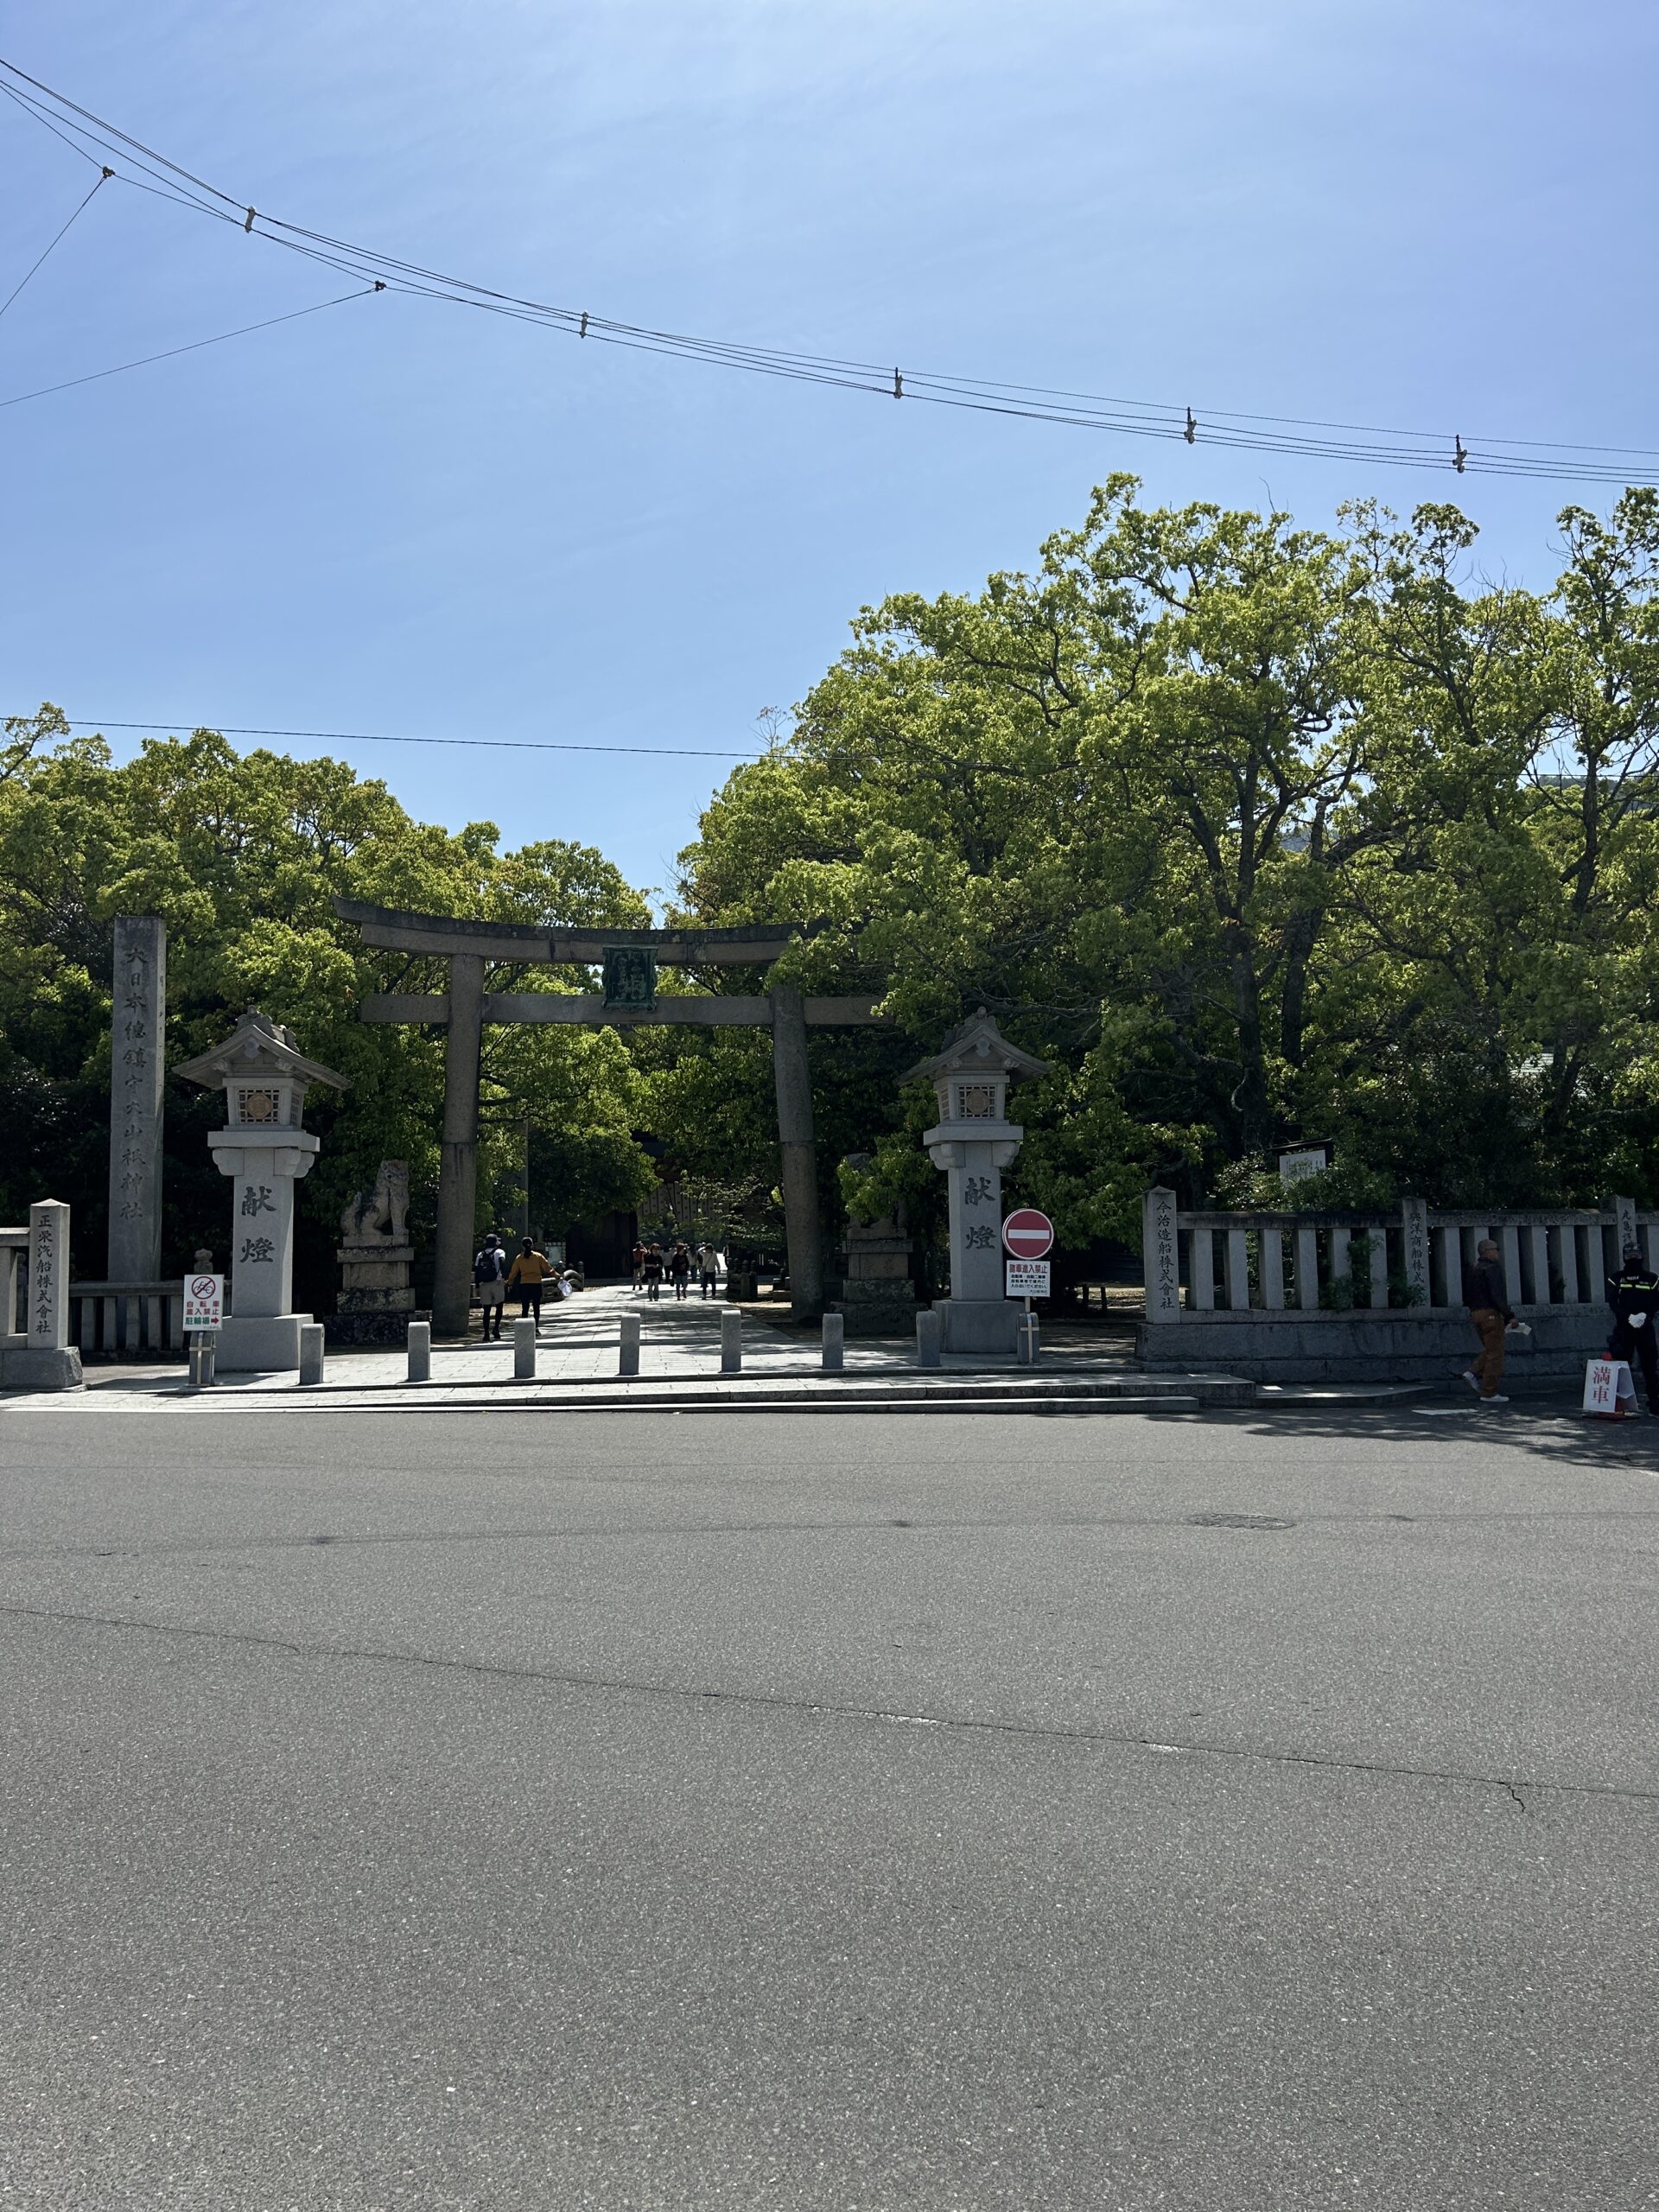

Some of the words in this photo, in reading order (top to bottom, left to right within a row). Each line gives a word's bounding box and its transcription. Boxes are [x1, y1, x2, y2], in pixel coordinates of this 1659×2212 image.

[240, 1185, 276, 1262] 献燈
[964, 1177, 996, 1249] 献燈
[35, 1214, 54, 1335] 正栄汽船株式會社
[1156, 1200, 1175, 1311] 今治造船株式會社
[185, 1316, 210, 1325] 駐輪場
[1592, 1366, 1611, 1404] 満車
